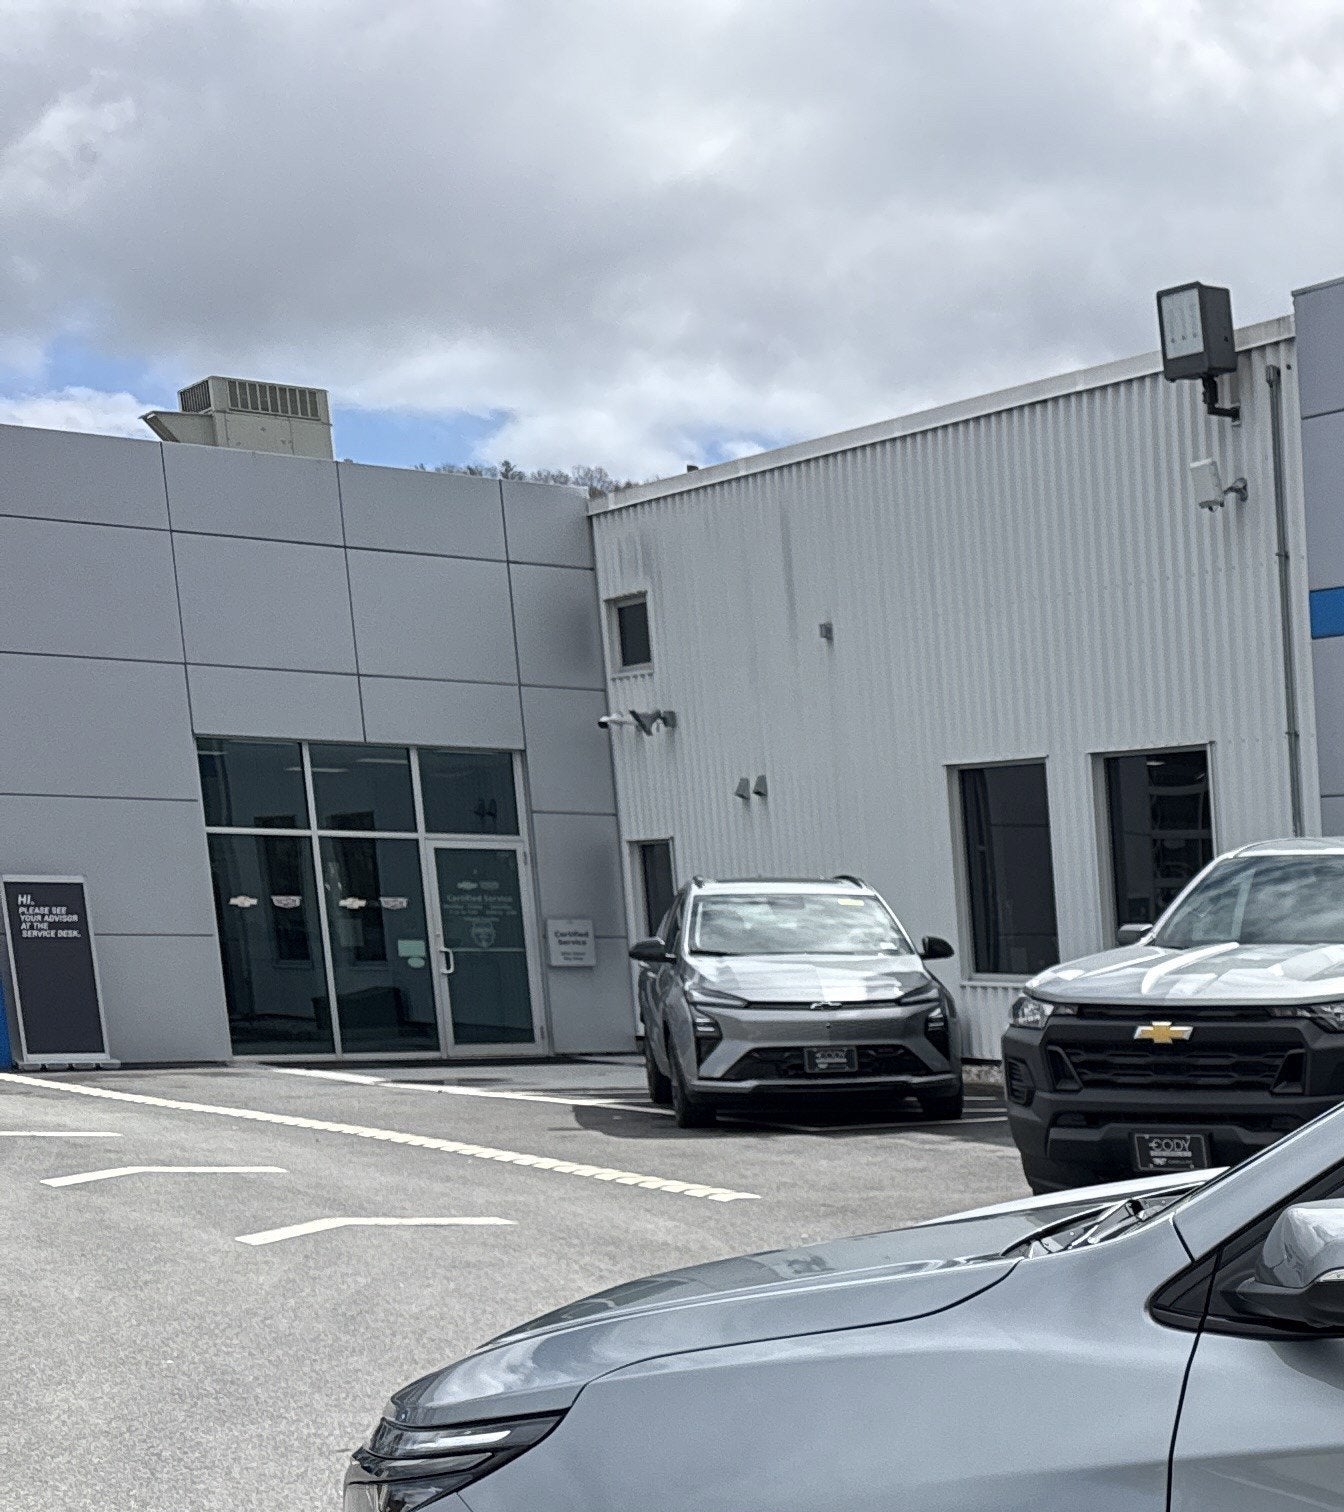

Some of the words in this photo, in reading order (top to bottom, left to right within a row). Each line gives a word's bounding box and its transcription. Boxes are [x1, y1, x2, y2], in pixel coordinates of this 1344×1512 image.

[17, 894, 36, 905] HI.
[18, 906, 50, 914] PLEASE
[51, 906, 67, 914] SEE
[20, 914, 42, 922] YOUR
[43, 914, 79, 922] ADVISOR
[20, 922, 32, 930] AT
[33, 922, 49, 930] THE
[21, 929, 56, 938] SERVICE
[57, 929, 82, 938] DESK.
[553, 930, 589, 939] Certified
[1149, 1138, 1191, 1152] CODY
